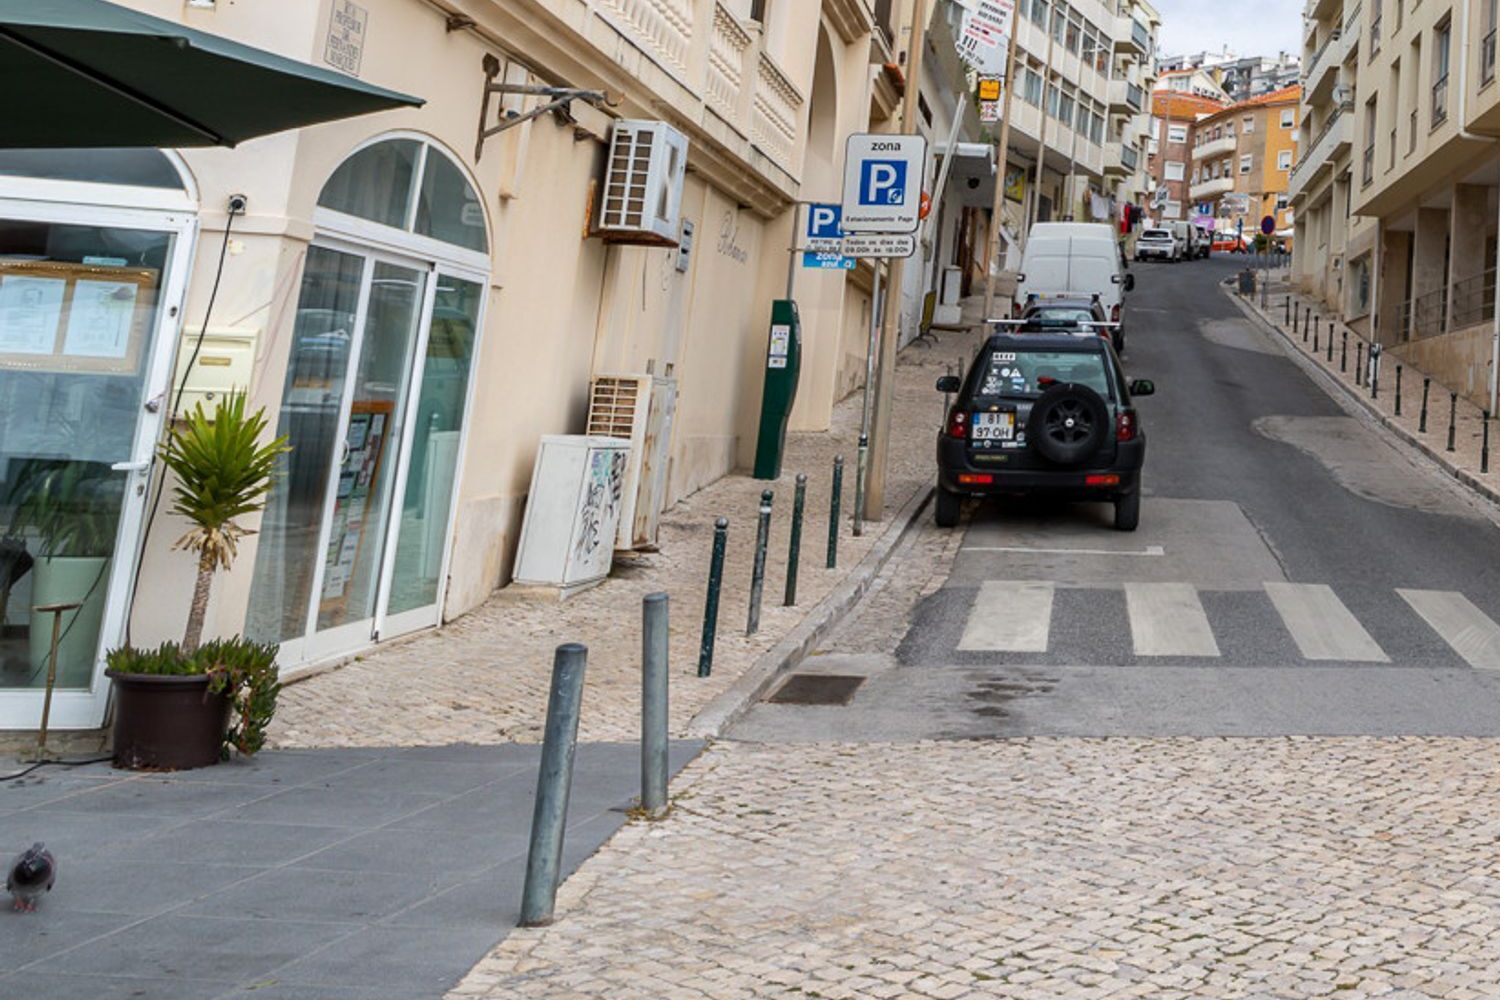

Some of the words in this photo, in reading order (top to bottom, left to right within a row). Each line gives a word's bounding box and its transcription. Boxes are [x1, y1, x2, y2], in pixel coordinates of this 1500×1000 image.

[871, 142, 901, 152] zona
[868, 164, 897, 202] P
[812, 208, 835, 235] P
[845, 215, 895, 223] Estacionamento
[898, 215, 914, 224] Pago
